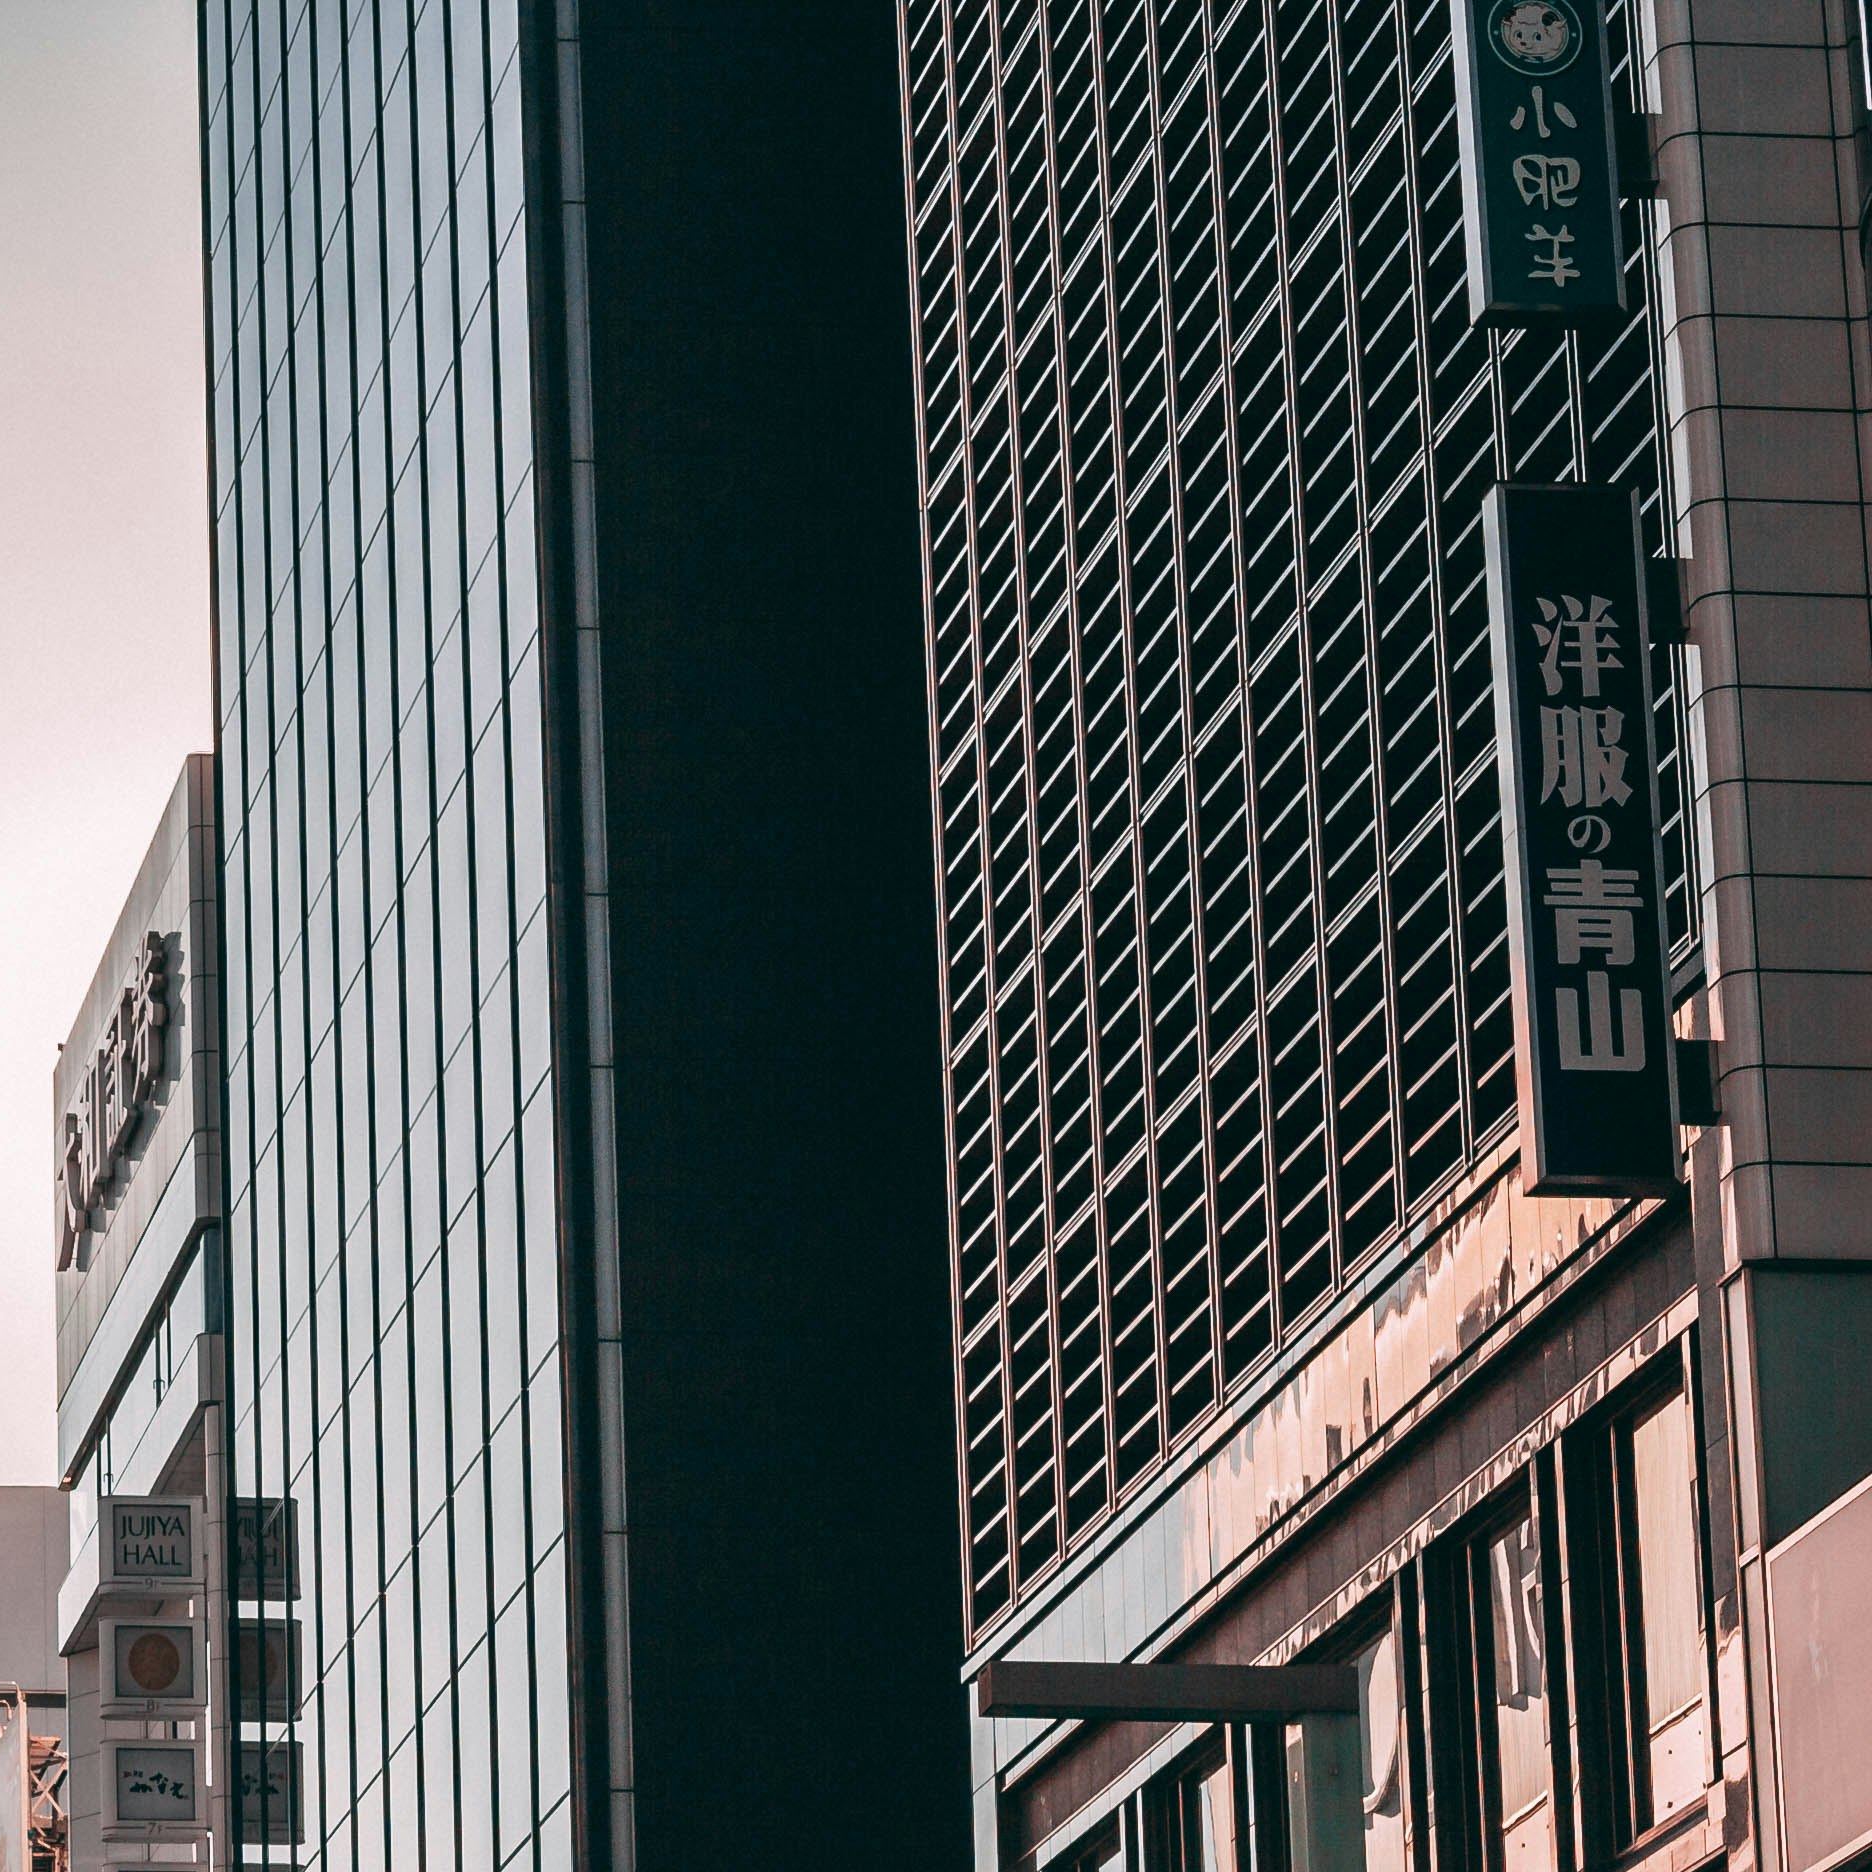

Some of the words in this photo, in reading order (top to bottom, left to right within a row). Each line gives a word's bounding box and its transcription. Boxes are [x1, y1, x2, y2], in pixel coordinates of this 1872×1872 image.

[1531, 593, 1647, 1074] 洋服の青山
[119, 1515, 186, 1540] JUJIYA
[122, 1541, 183, 1567] HALL
